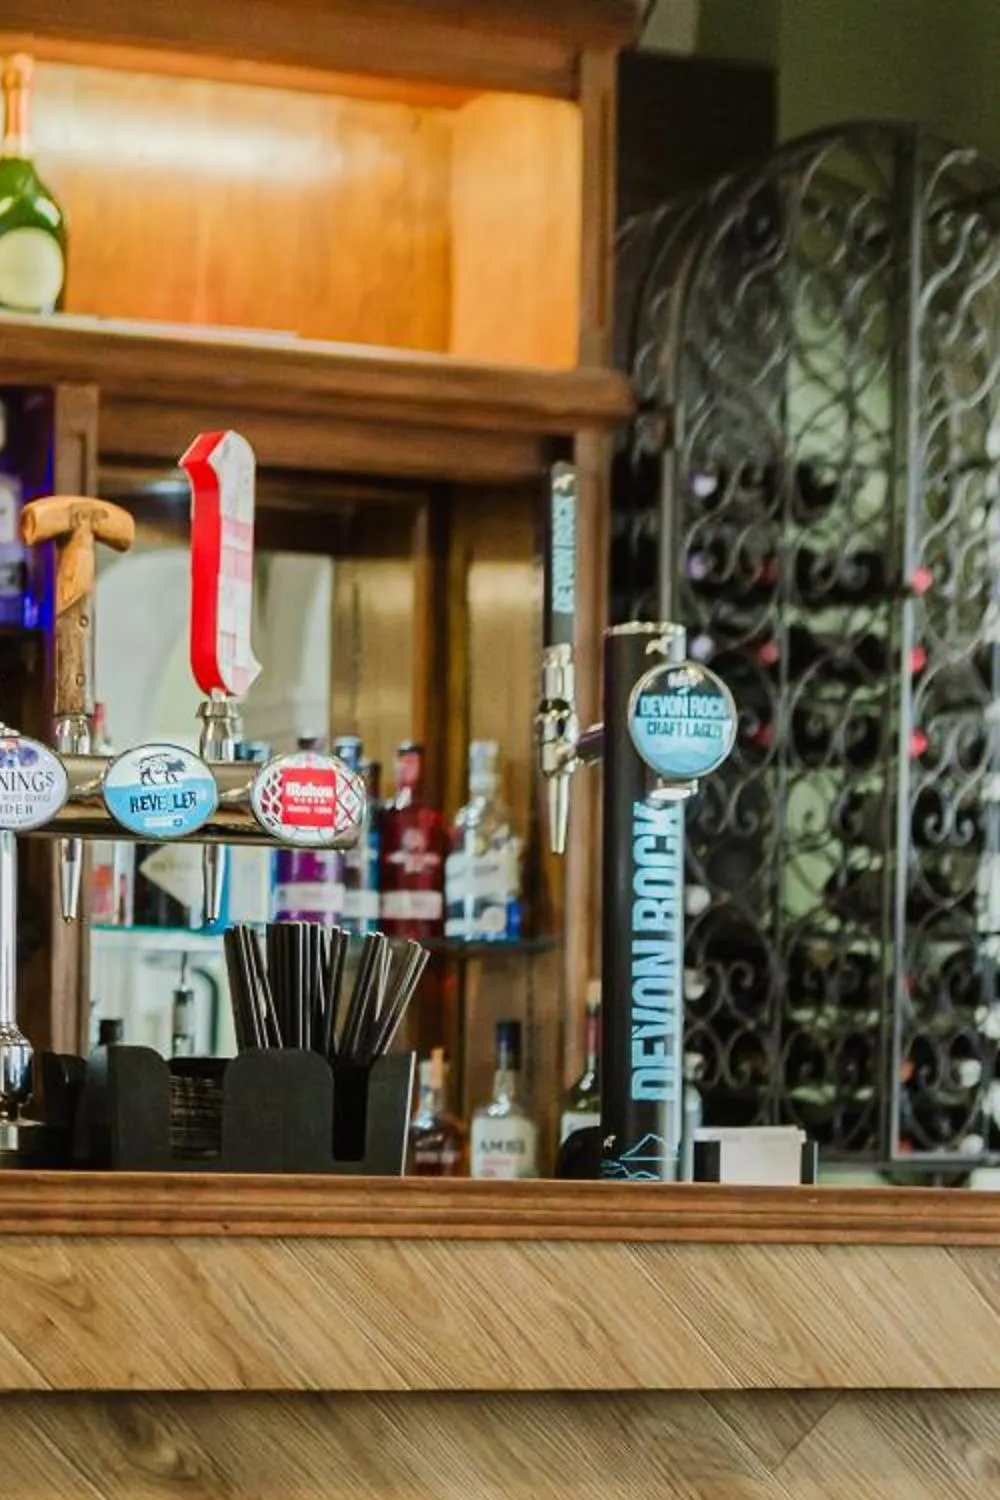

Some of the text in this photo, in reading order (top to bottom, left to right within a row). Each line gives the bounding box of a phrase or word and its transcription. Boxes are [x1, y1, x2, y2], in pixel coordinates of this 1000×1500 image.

[639, 695, 688, 716] DEVON
[647, 721, 681, 735] CRAFT
[630, 800, 682, 1101] DEVON ROCK
